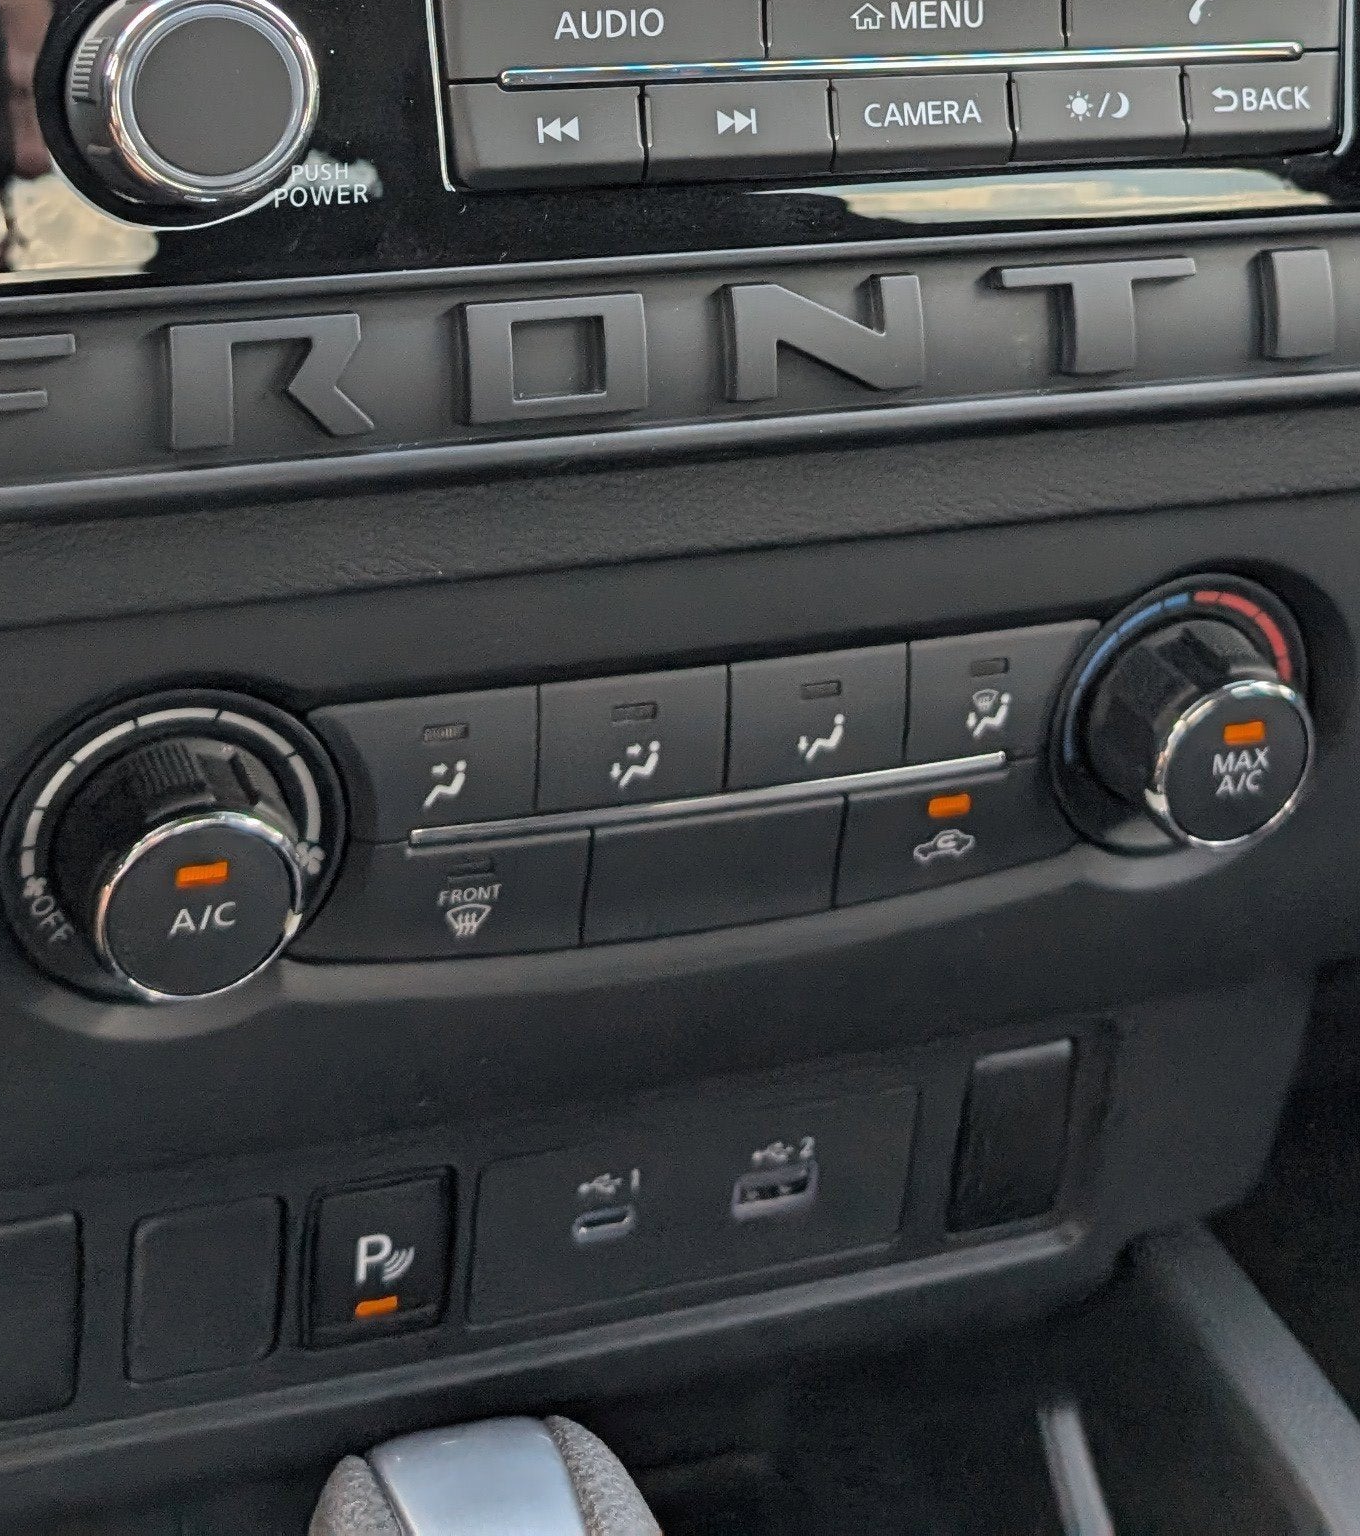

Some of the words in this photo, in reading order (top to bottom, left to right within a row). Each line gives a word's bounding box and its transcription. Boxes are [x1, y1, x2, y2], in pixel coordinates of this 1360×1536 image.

[553, 8, 666, 41] AUDIO
[889, 0, 985, 30] MENU
[863, 98, 983, 128] CAMERA
[1242, 84, 1312, 113] BACK
[289, 162, 351, 182] PUSH
[273, 183, 370, 209] POWER
[1211, 745, 1270, 774] MAX
[1214, 770, 1262, 800] A/C
[438, 883, 503, 906] FRONT
[167, 900, 238, 939] A/C
